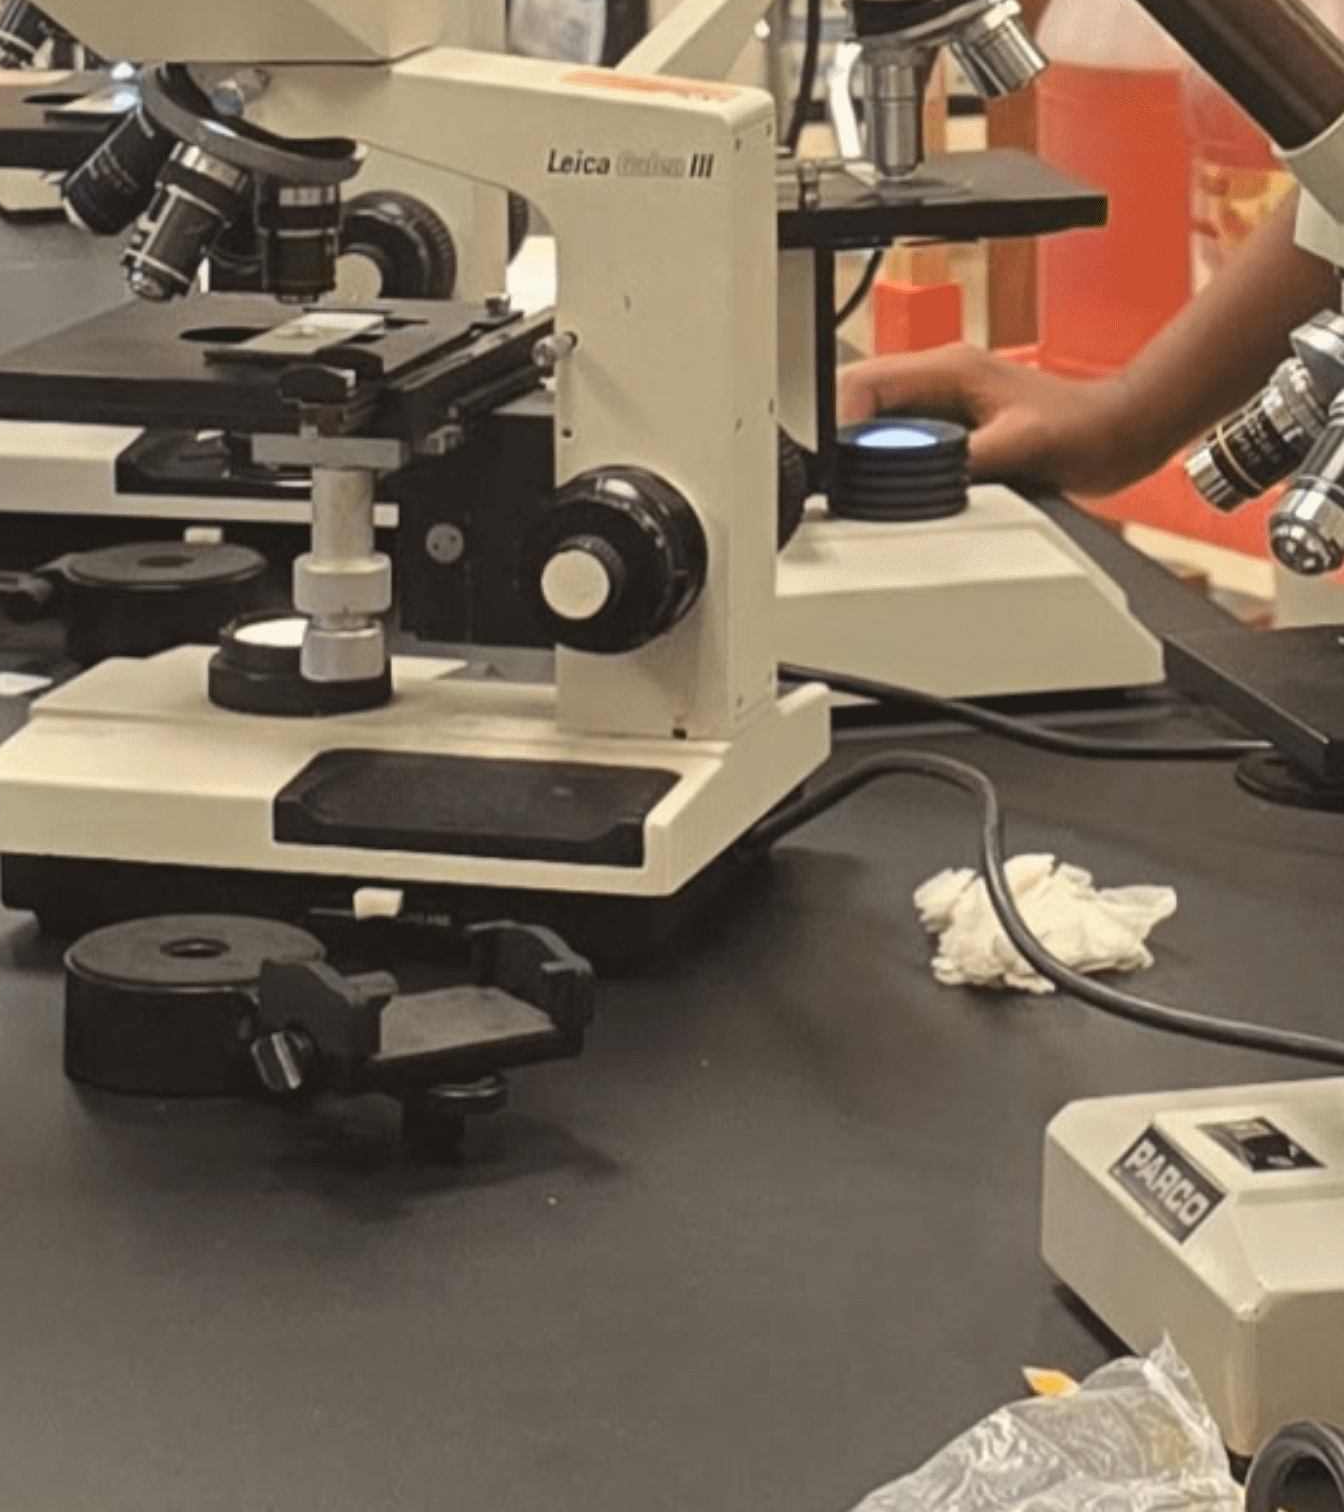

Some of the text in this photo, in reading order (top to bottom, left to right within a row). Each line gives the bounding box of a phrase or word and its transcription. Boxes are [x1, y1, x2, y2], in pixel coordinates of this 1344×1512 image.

[546, 148, 611, 176] Leica
[688, 152, 715, 178] III
[1122, 1136, 1211, 1227] PARCO
